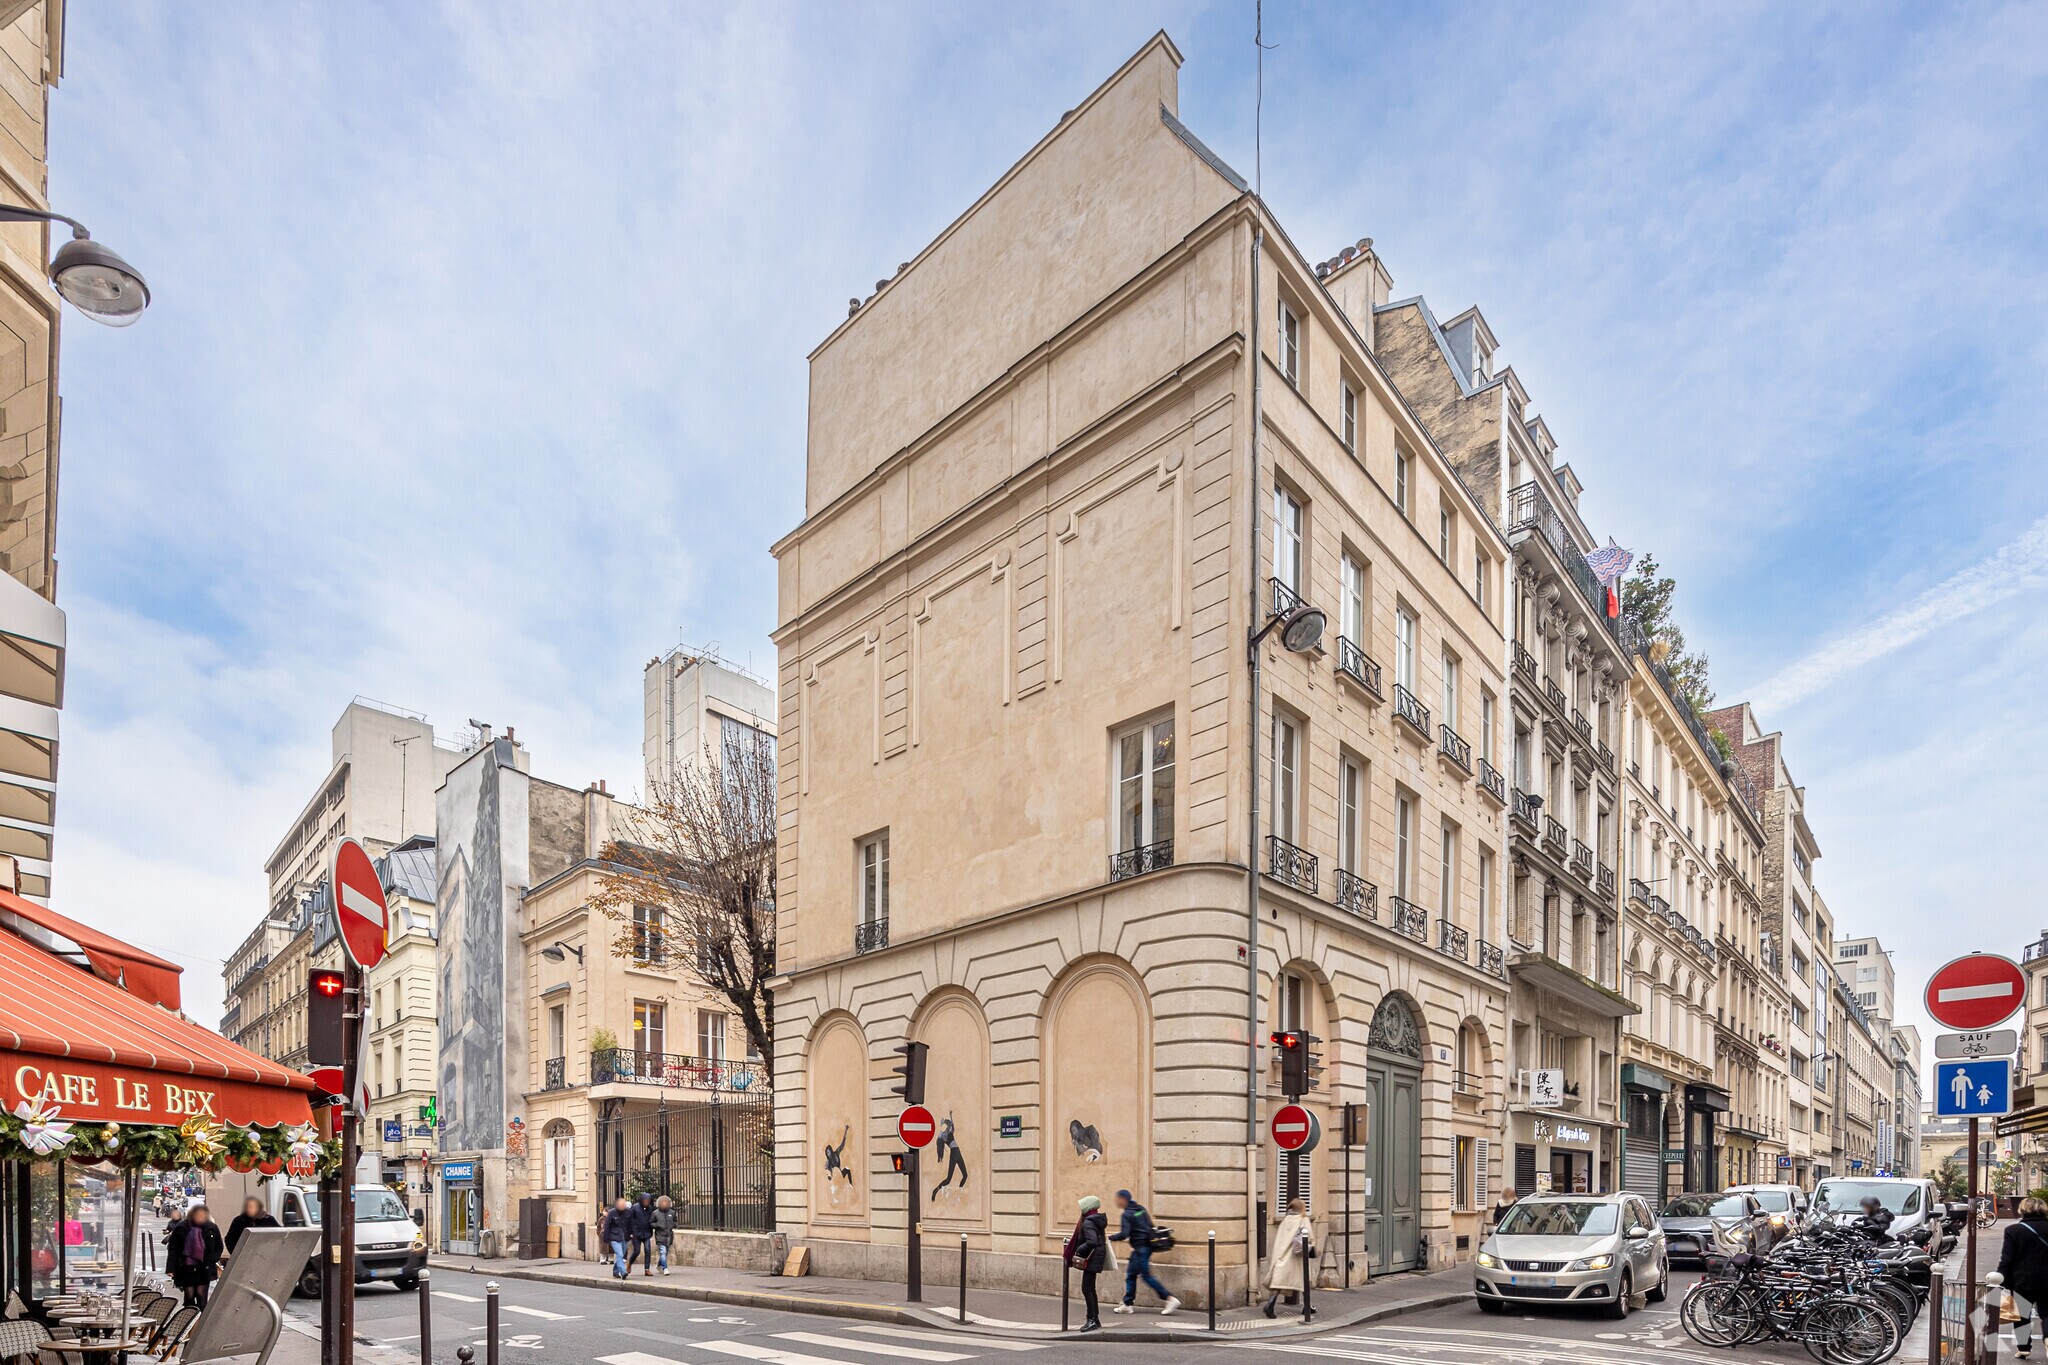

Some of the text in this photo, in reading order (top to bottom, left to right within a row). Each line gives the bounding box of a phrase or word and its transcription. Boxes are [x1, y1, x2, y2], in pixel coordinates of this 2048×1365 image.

[1959, 1033, 1991, 1042] SAUF
[15, 1066, 217, 1118] CAFE LE BEX
[445, 1166, 472, 1176] CHANGE
